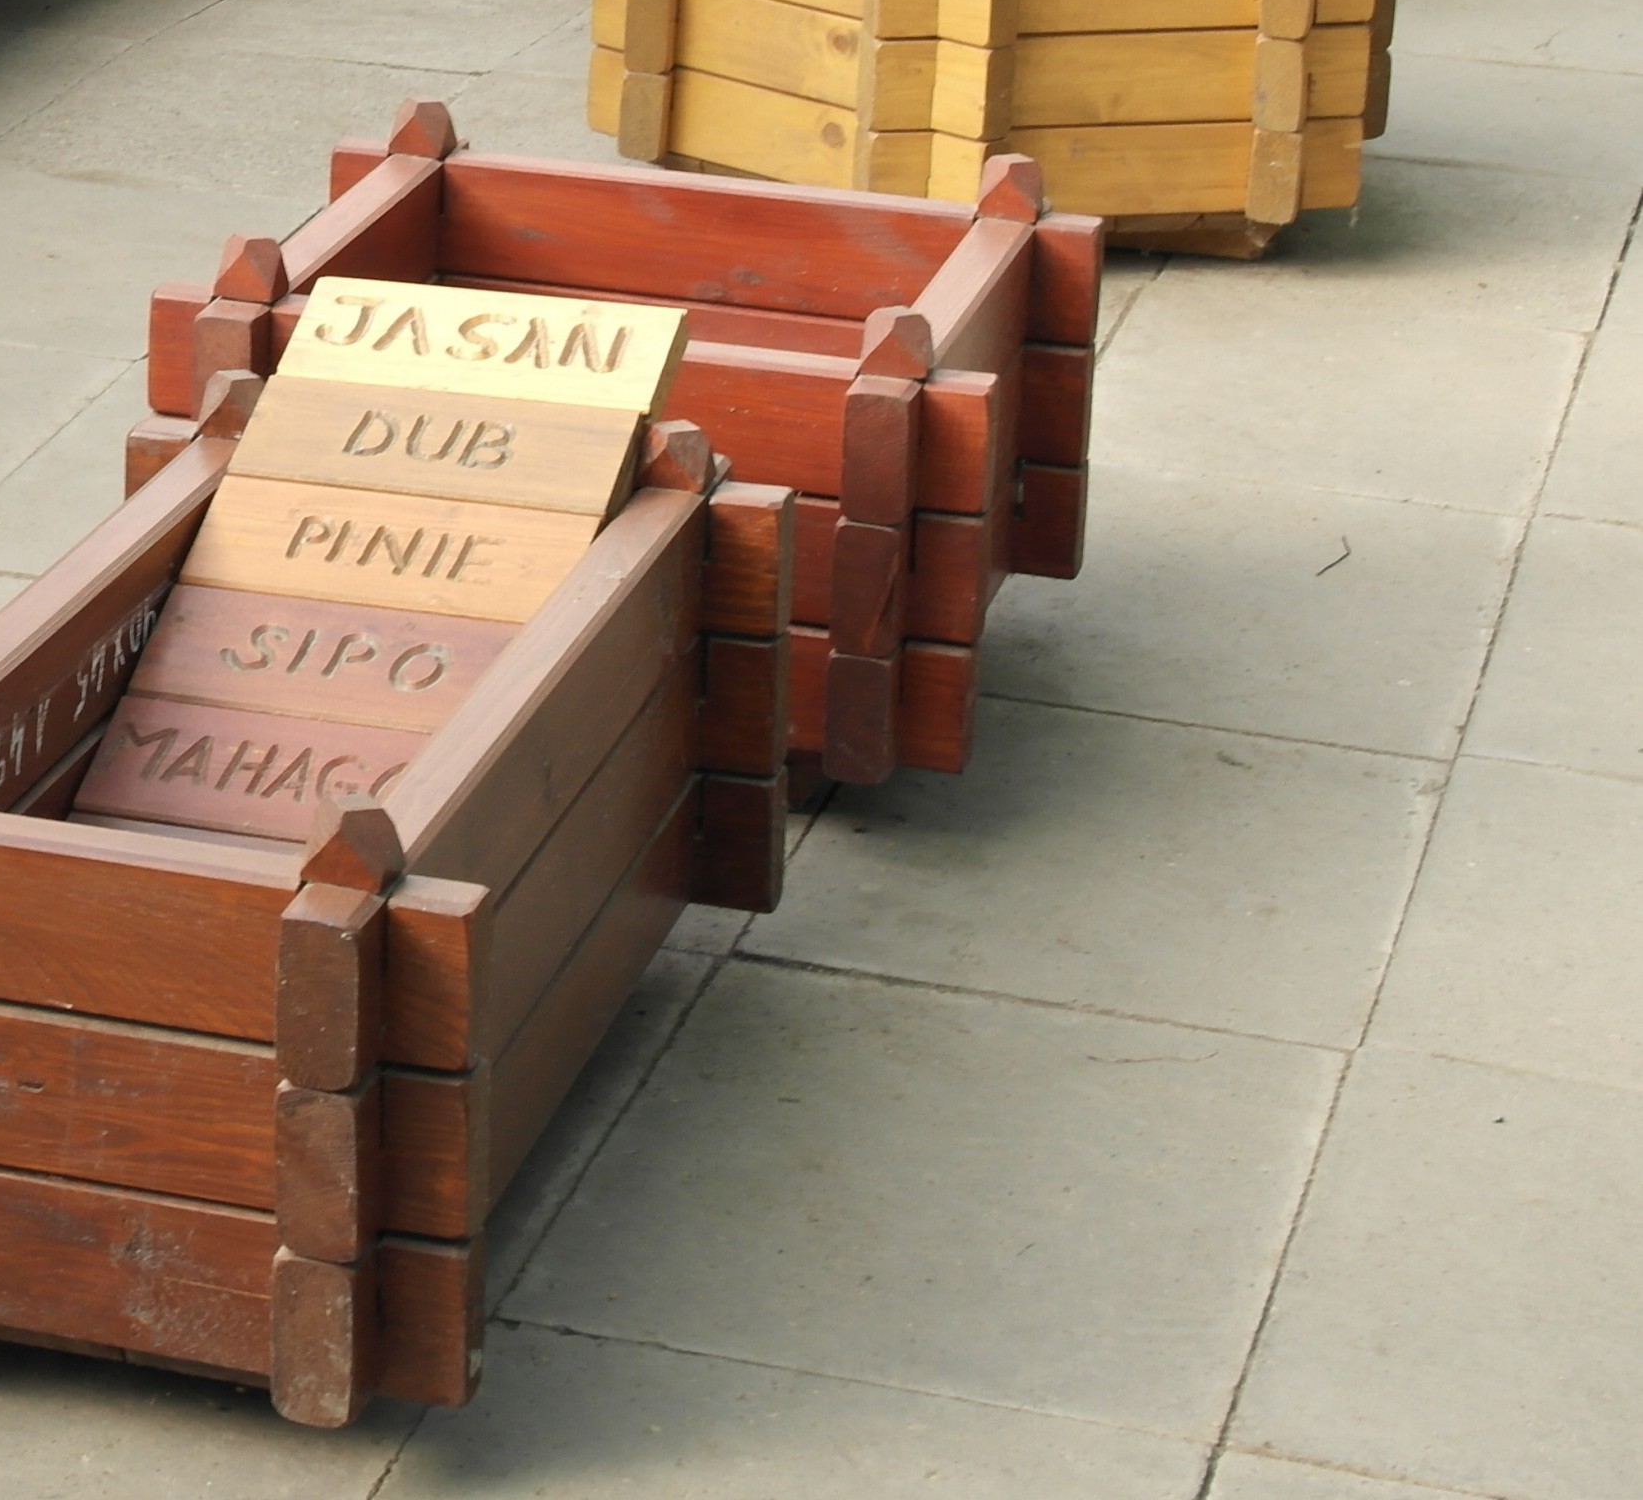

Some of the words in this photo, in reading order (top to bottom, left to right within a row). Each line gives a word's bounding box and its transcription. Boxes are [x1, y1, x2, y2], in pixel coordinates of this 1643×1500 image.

[314, 293, 633, 376] JASAN
[341, 408, 517, 471] DUB
[284, 514, 505, 585] PINIE
[218, 622, 454, 693] SIPO
